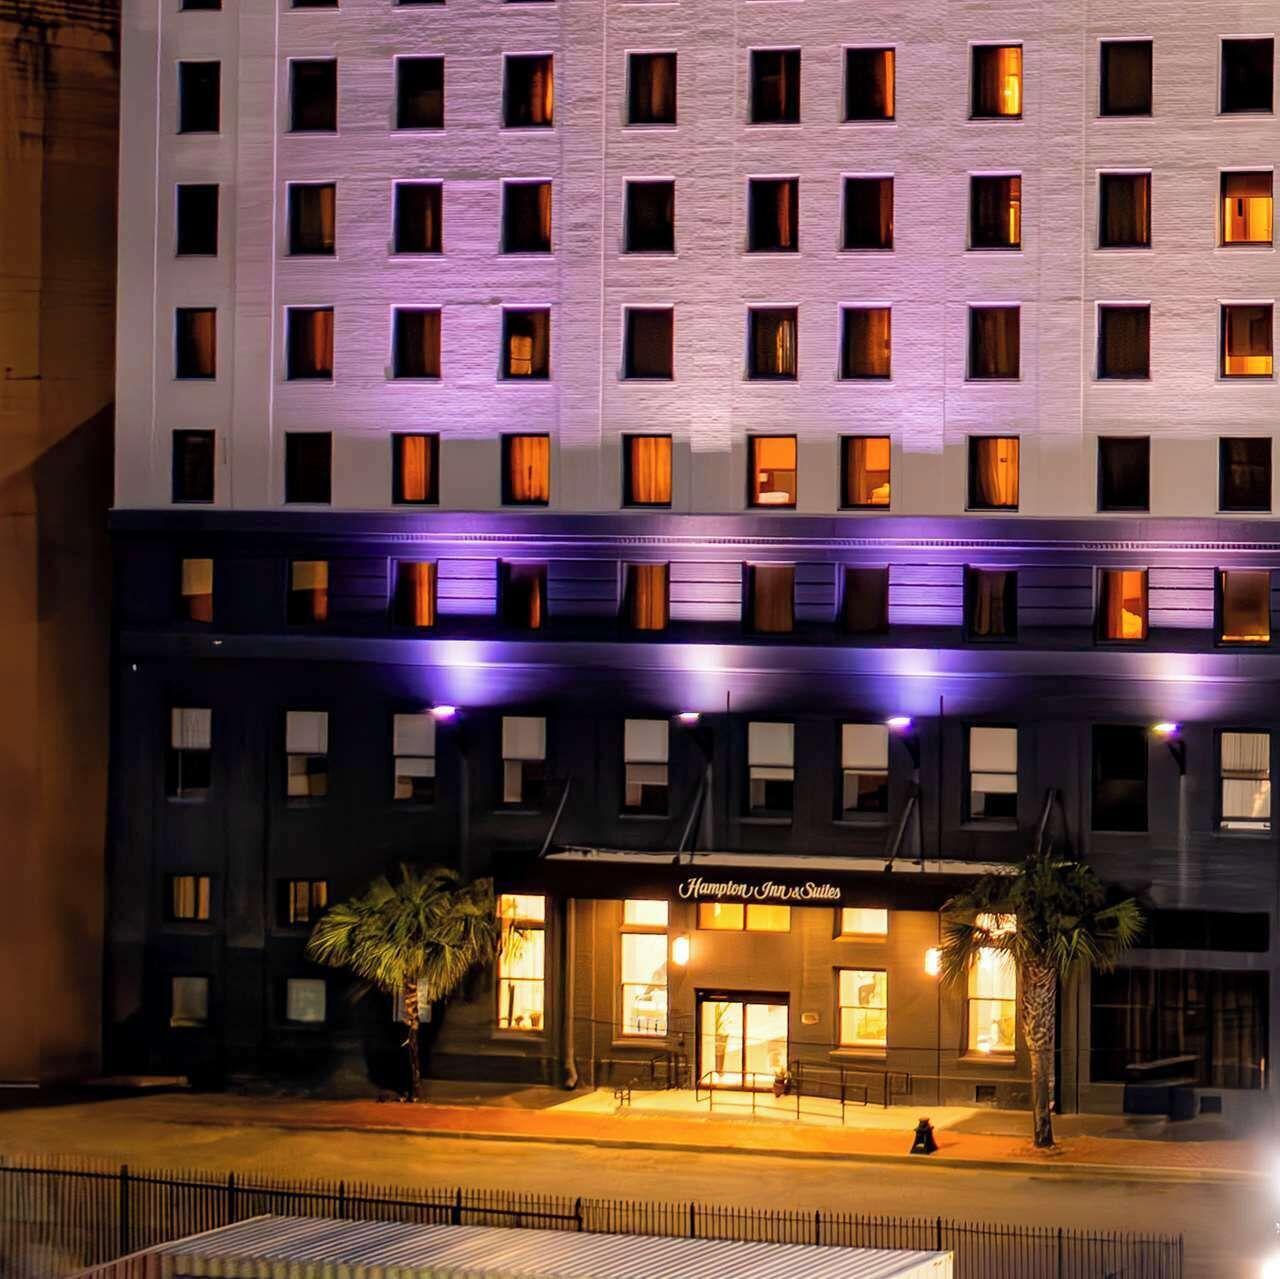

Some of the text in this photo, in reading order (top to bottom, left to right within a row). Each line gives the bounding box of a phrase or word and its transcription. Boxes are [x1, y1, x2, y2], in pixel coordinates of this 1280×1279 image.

[679, 877, 841, 900] Hampton Inn & Suites
